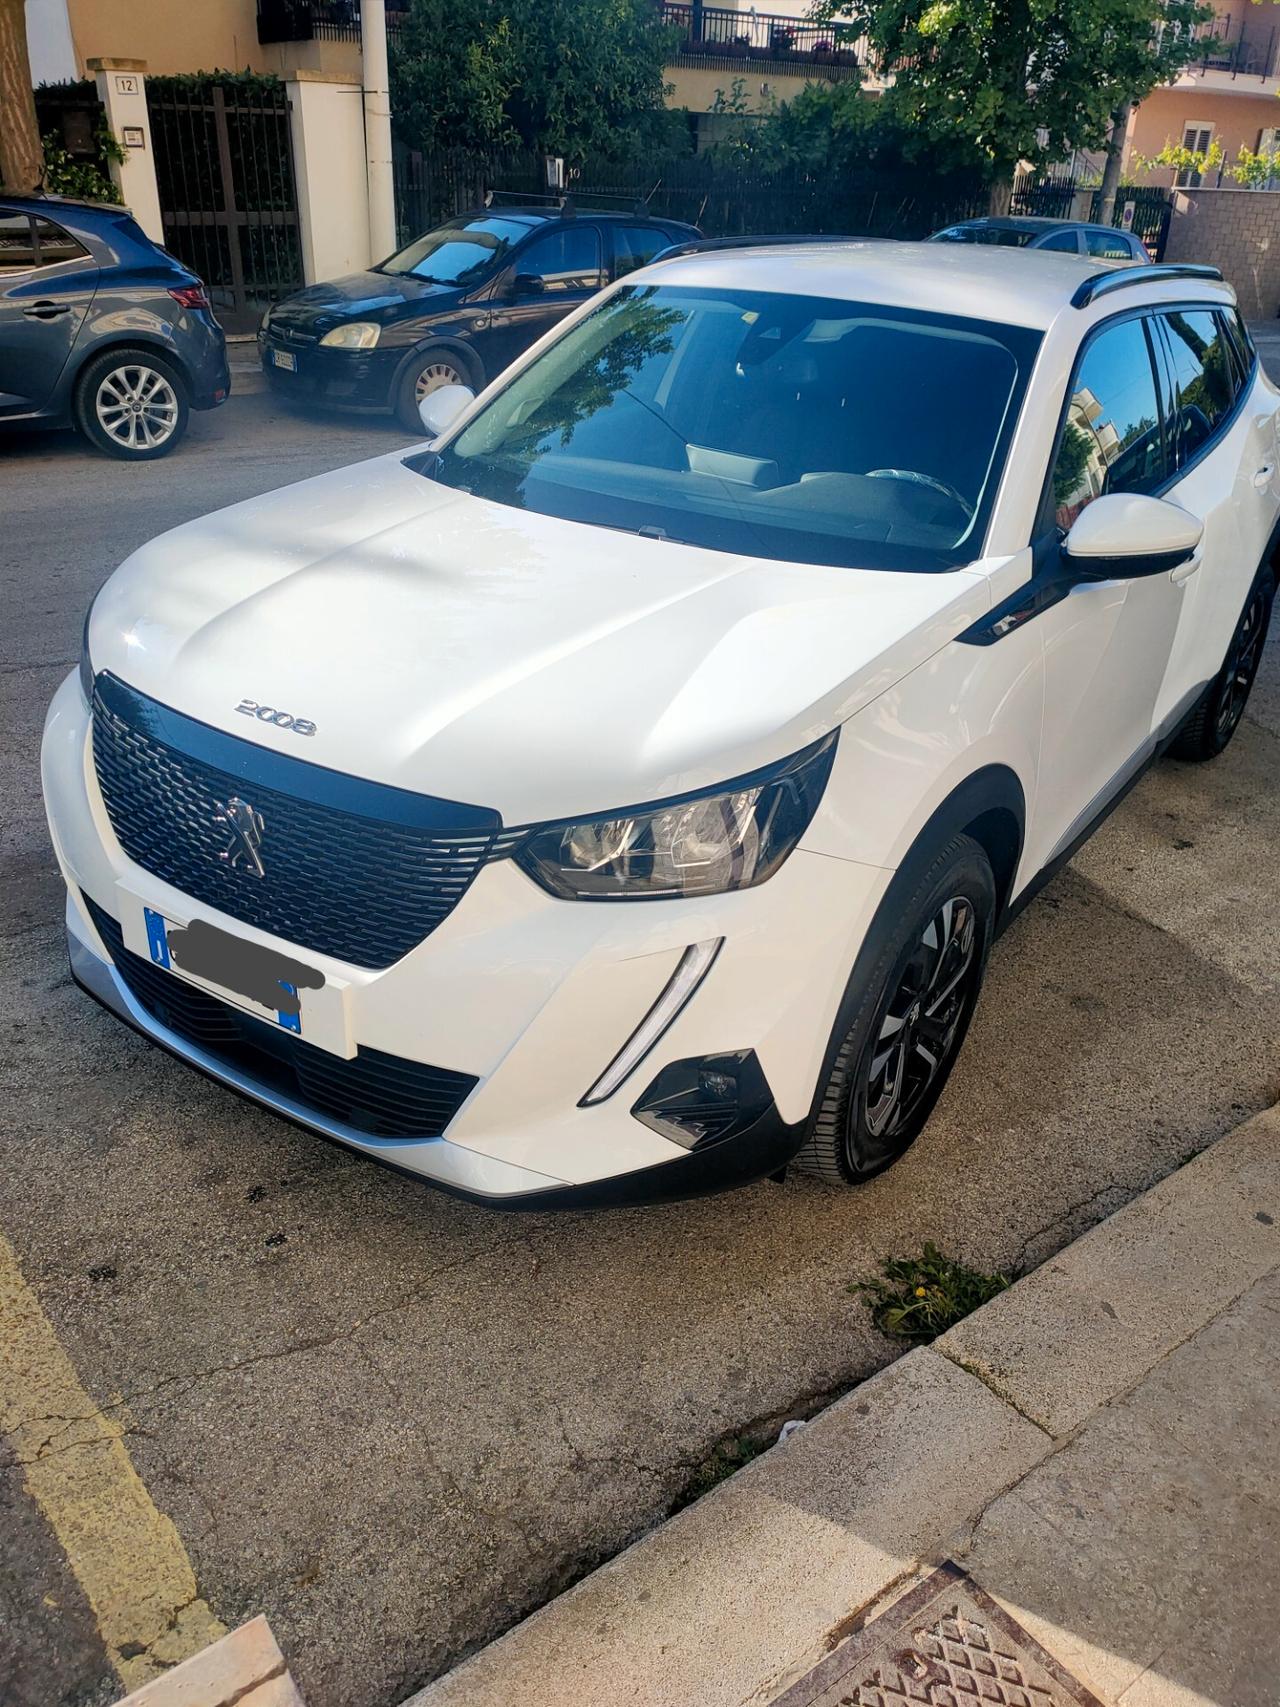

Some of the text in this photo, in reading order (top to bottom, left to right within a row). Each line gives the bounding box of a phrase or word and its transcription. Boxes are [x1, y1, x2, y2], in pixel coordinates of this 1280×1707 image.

[121, 80, 133, 91] 12
[569, 168, 580, 179] 10
[233, 699, 317, 737] 2008
